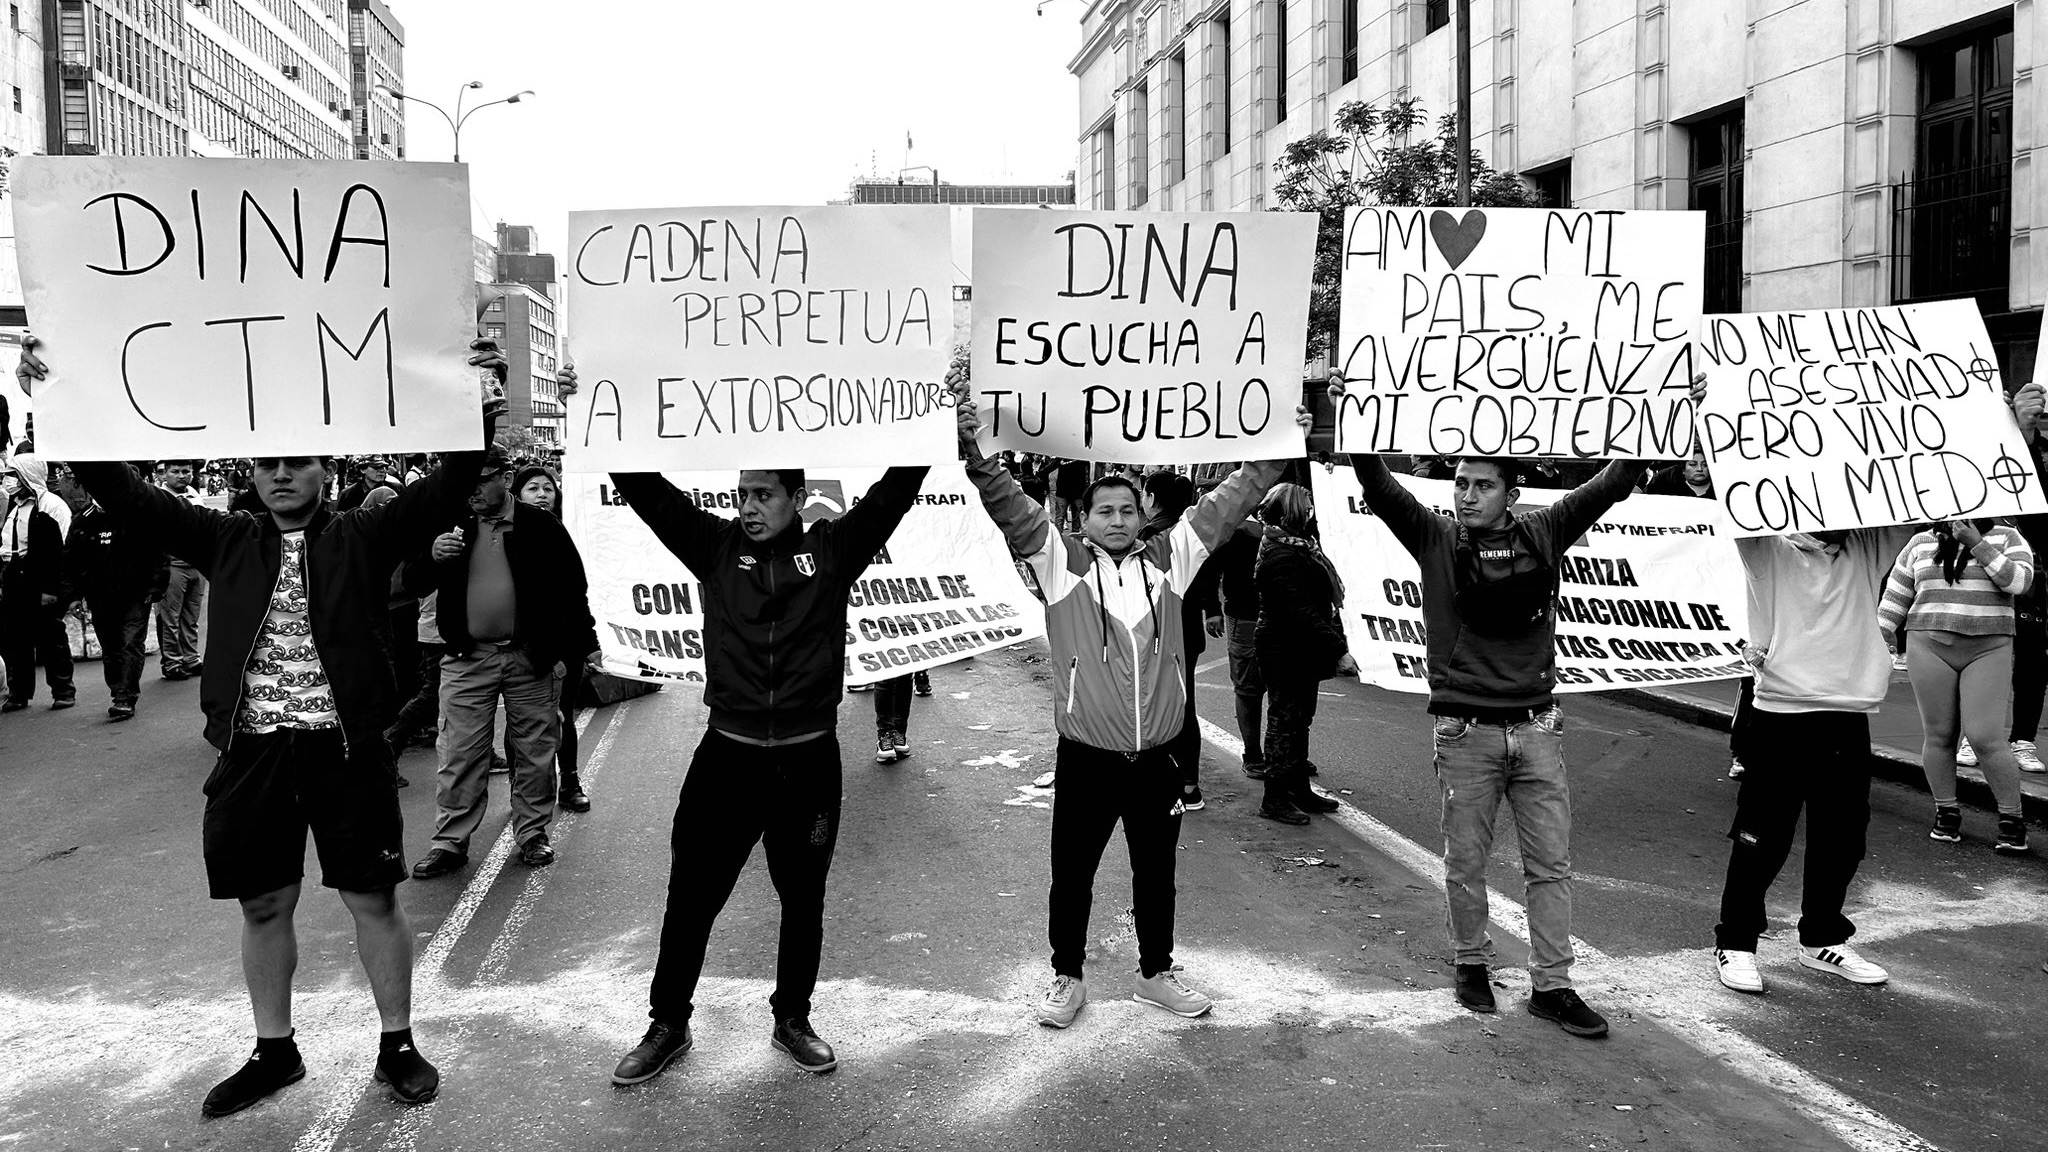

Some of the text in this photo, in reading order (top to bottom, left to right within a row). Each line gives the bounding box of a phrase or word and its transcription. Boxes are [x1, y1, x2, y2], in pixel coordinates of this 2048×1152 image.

[84, 184, 390, 288] DINA
[576, 216, 808, 286] CADENA
[1054, 222, 1238, 311] DINA
[1544, 210, 1626, 277] MI
[673, 287, 932, 349] PERPETUA
[996, 311, 1266, 367] ESCUCHA A
[1594, 281, 1688, 342] ME
[1757, 314, 1821, 366] ME
[1825, 307, 1921, 362] HAN
[121, 307, 396, 431] CTM
[1343, 332, 1694, 396] AVERGÜENZA
[585, 373, 957, 447] A EXTORSIONADORES
[981, 378, 1270, 449] TU PUEBLO
[1339, 393, 1694, 458] MI GOBIERNO
[1704, 404, 1946, 463] PERO VIVO
[1591, 522, 1715, 536] APYMEFRAPI
[1725, 471, 1825, 532] CON
[632, 583, 693, 615] CON
[848, 577, 940, 607] CIONAL
[937, 574, 975, 600] DE
[1560, 555, 1639, 587] ARIZA
[859, 609, 968, 642] CONTRA
[966, 602, 1020, 623] LAS
[1382, 578, 1424, 608] CO
[1688, 603, 1731, 632] DE
[1589, 667, 1615, 683] Y
